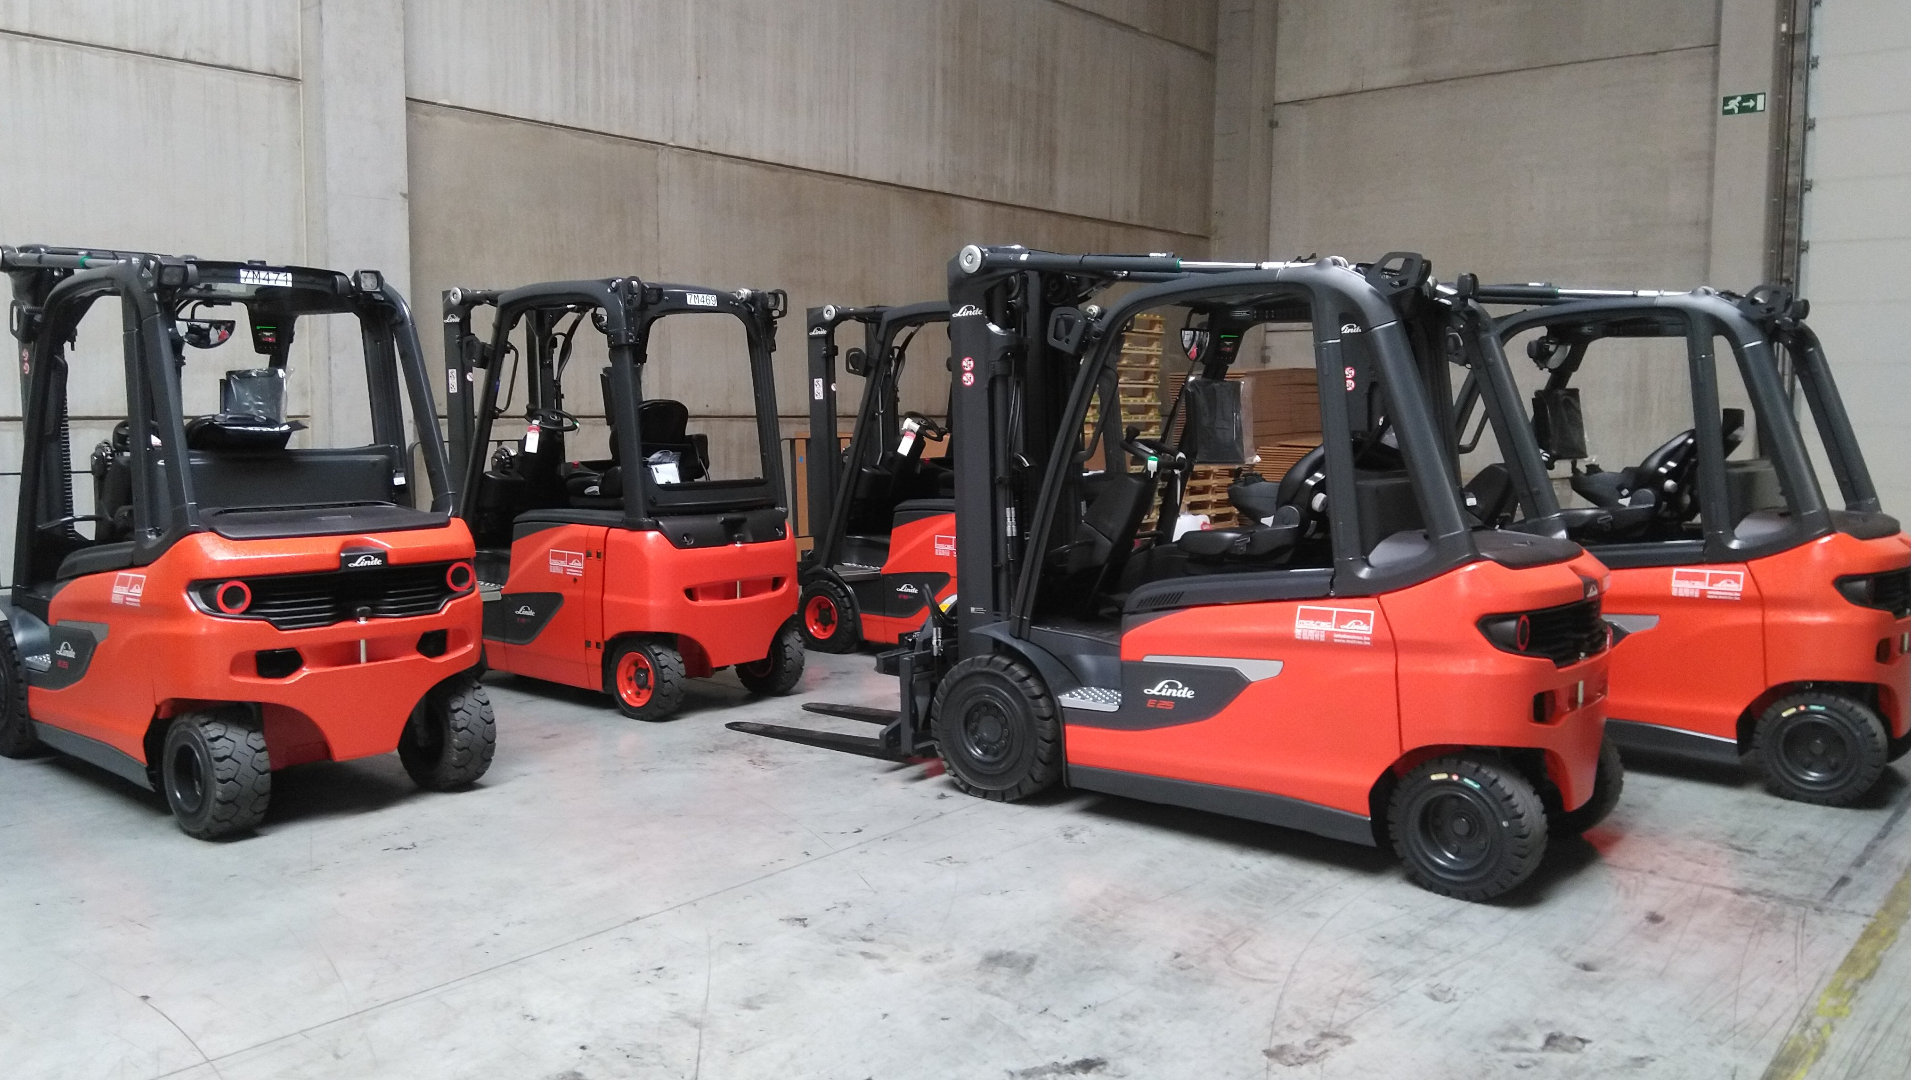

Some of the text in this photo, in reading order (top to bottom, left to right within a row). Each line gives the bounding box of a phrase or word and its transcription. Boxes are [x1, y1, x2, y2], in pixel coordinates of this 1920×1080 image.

[243, 269, 288, 286] 7M471
[687, 293, 717, 306] 7M469
[952, 304, 983, 318] Linde
[347, 554, 383, 568] Linde
[896, 583, 919, 594] Linde
[1143, 679, 1195, 699] Linde
